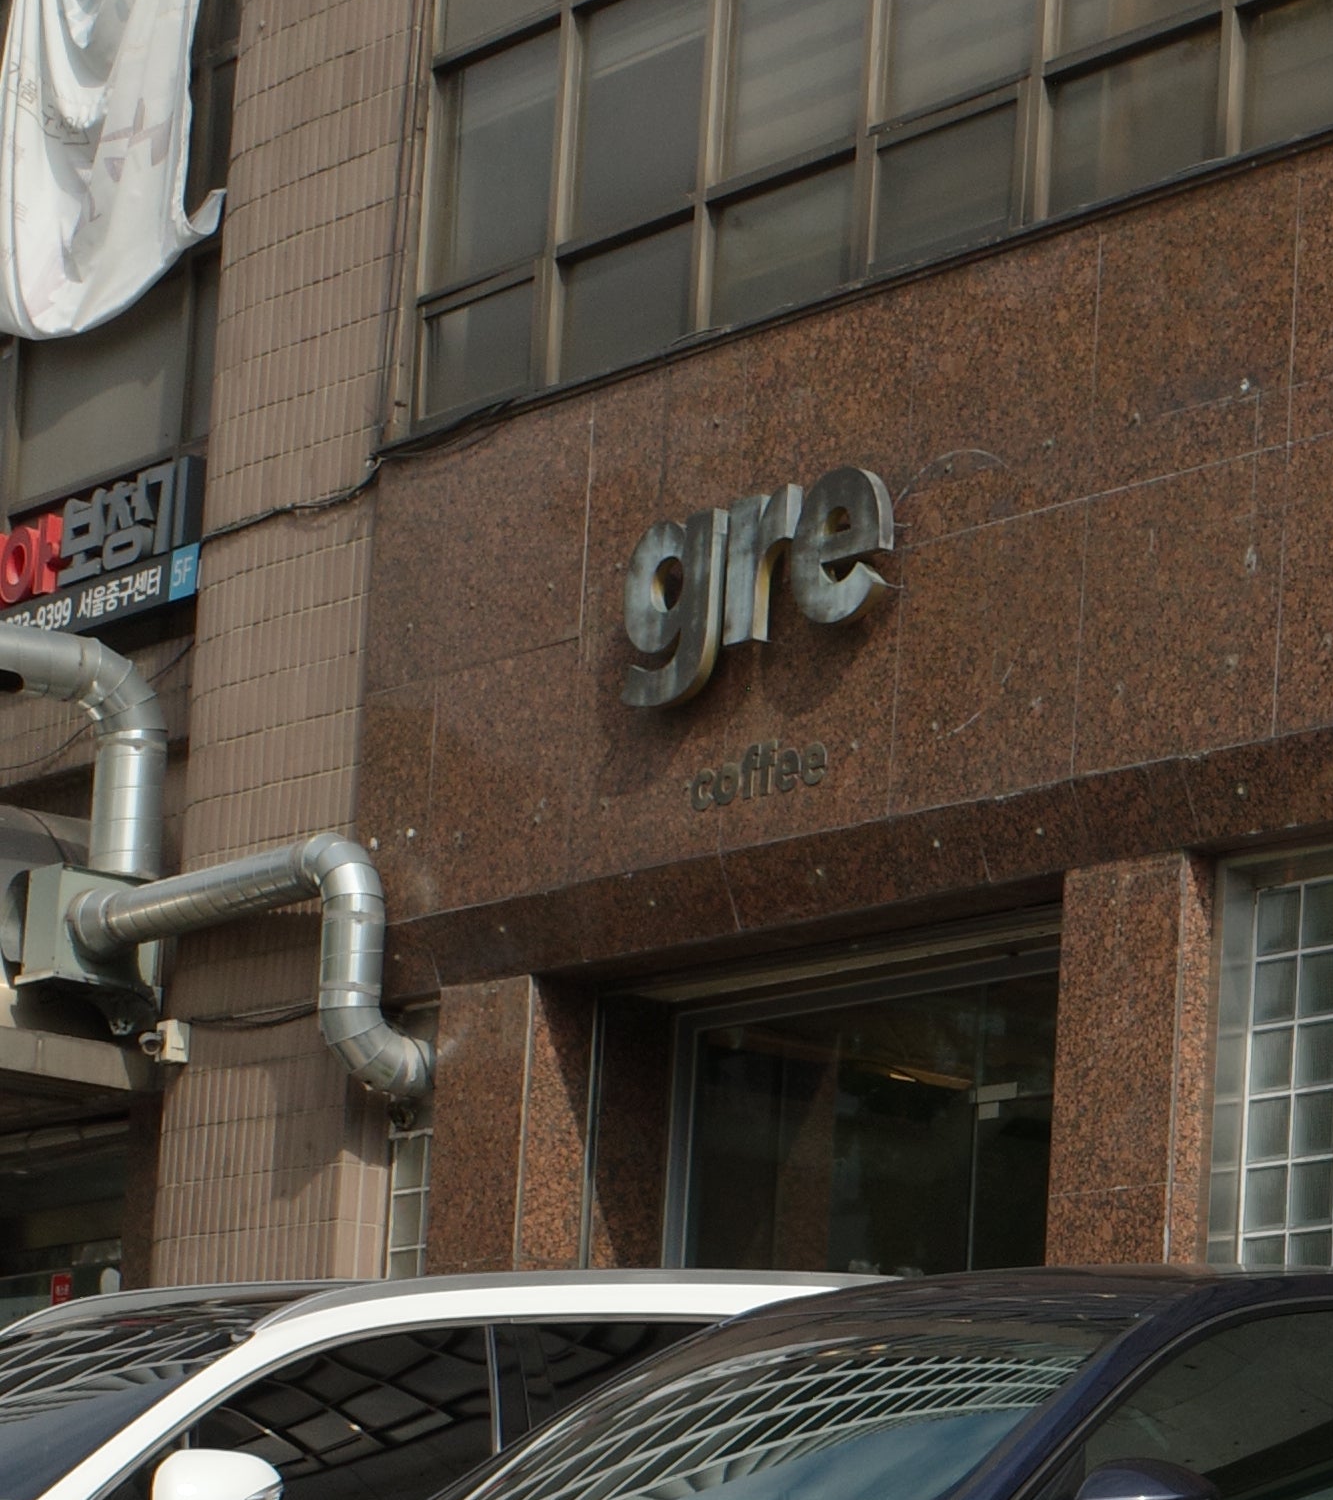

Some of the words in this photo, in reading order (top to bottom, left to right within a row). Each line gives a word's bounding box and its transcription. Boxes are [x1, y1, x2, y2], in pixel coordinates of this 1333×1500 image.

[76, 565, 162, 619] 서울중구센터
[173, 556, 194, 587] 5F
[620, 466, 895, 707] gre
[689, 739, 828, 812] coffee
